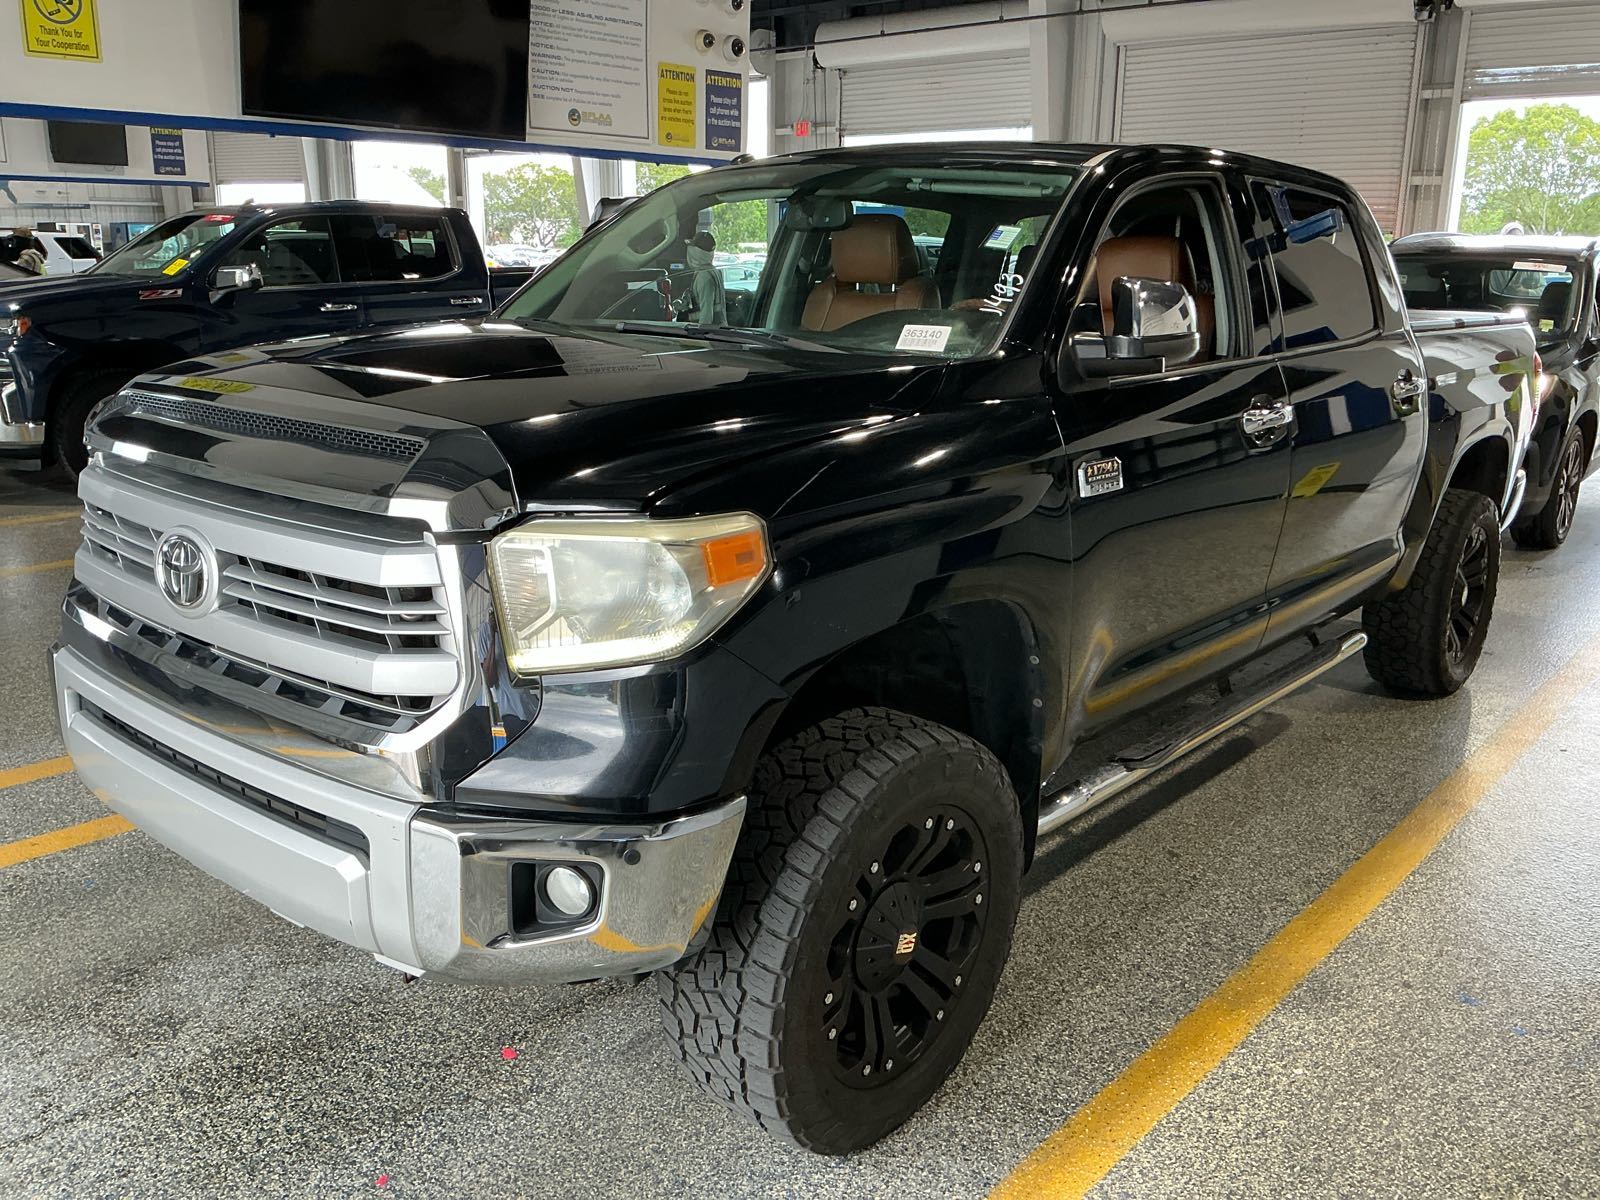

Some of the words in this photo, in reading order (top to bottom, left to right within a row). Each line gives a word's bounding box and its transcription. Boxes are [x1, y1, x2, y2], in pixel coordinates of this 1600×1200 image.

[605, 17, 643, 27] ARBITRATION
[40, 25, 59, 36] Thank
[60, 28, 72, 38] You
[73, 29, 82, 38] for
[35, 37, 50, 48] Your
[52, 39, 90, 51] Cooperation
[531, 42, 555, 50] NOTICE:
[531, 52, 562, 61] WARNING:
[531, 67, 560, 76] CAUTION:
[661, 69, 694, 82] ATTENTION
[707, 76, 741, 88] ATTENTION
[532, 84, 560, 92] AUCTION
[711, 94, 723, 104] Please
[723, 97, 731, 106] stay
[150, 127, 183, 136] ATTENTION
[903, 329, 943, 340] 363140
[1092, 461, 1113, 476] 1794
[1088, 471, 1119, 482] EDITION
